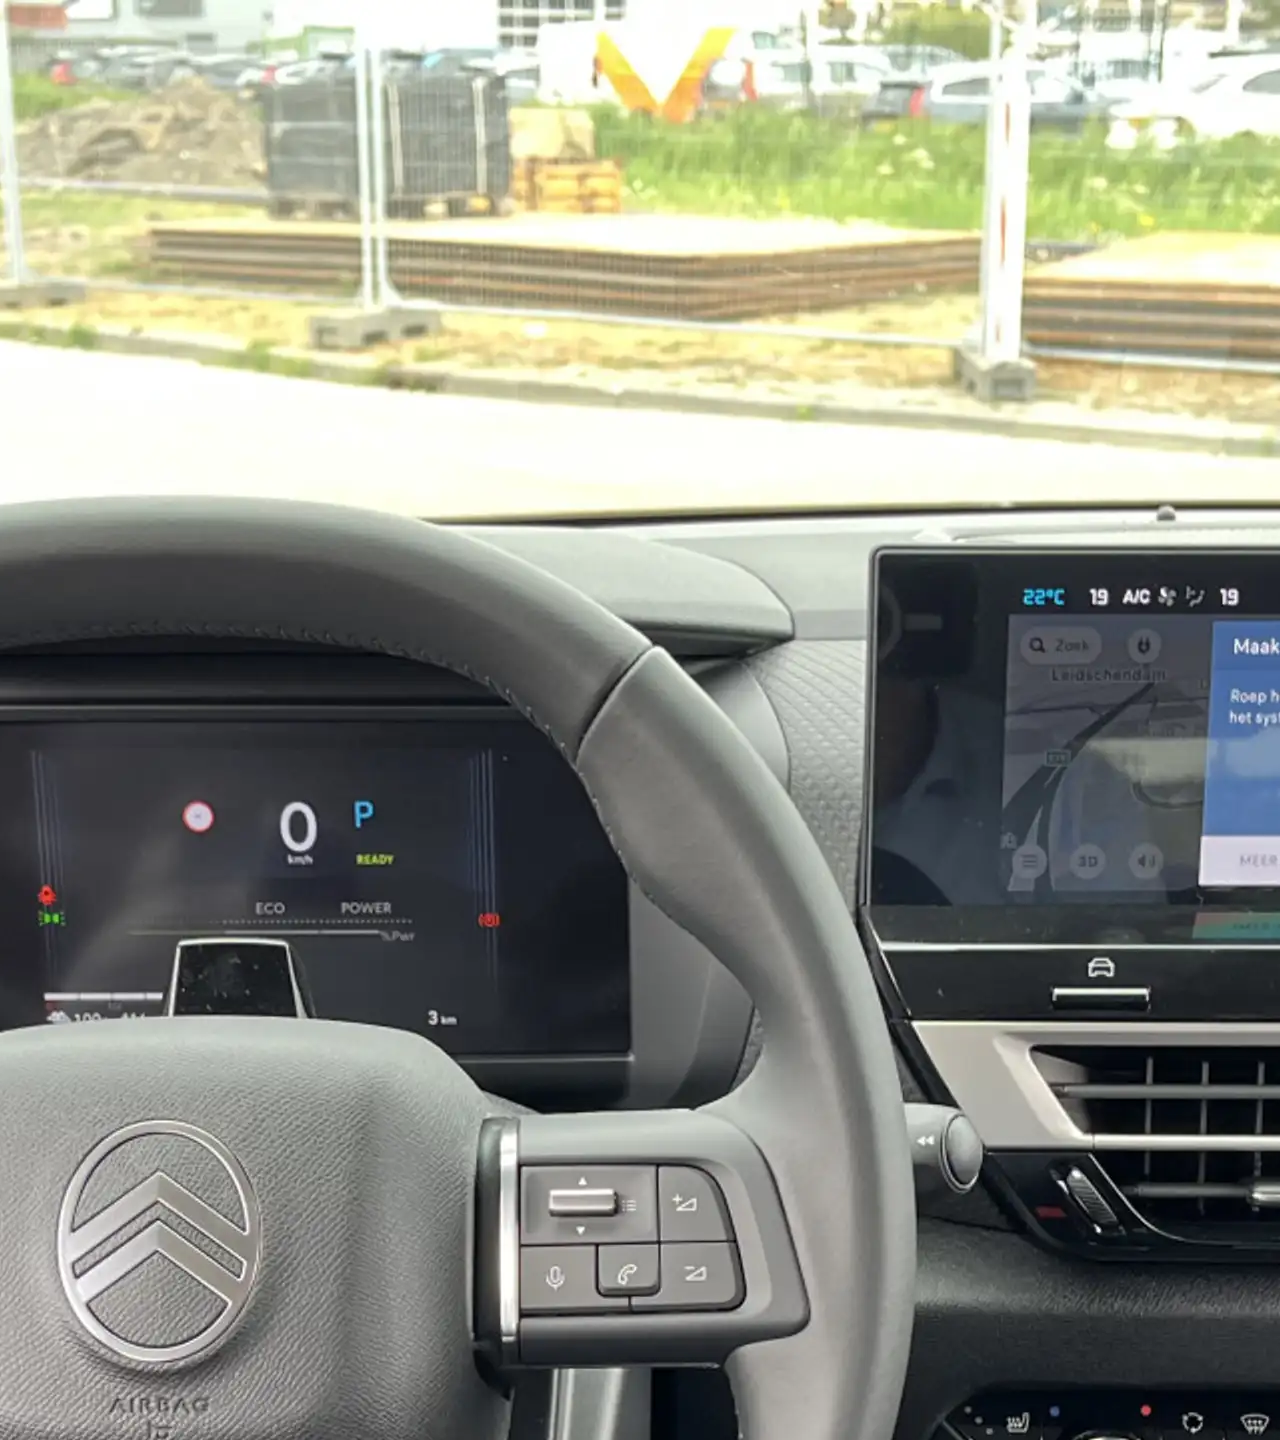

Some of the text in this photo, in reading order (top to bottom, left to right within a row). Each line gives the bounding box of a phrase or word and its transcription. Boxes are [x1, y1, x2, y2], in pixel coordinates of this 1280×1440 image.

[1022, 588, 1066, 605] 22°C
[1089, 588, 1110, 605] 19
[1122, 588, 1152, 605] A/C
[1220, 588, 1240, 605] 19
[1233, 638, 1280, 655] Maak
[1230, 688, 1267, 705] Roep
[1229, 709, 1252, 724] het
[354, 799, 375, 829] P
[279, 800, 318, 853] 0
[356, 854, 395, 866] READY
[1076, 854, 1099, 869] 3D
[1239, 852, 1277, 868] MEER
[255, 902, 286, 915] ECO
[340, 902, 392, 915] POWER
[427, 1008, 439, 1026] 3
[108, 1397, 209, 1414] AIRBAG
